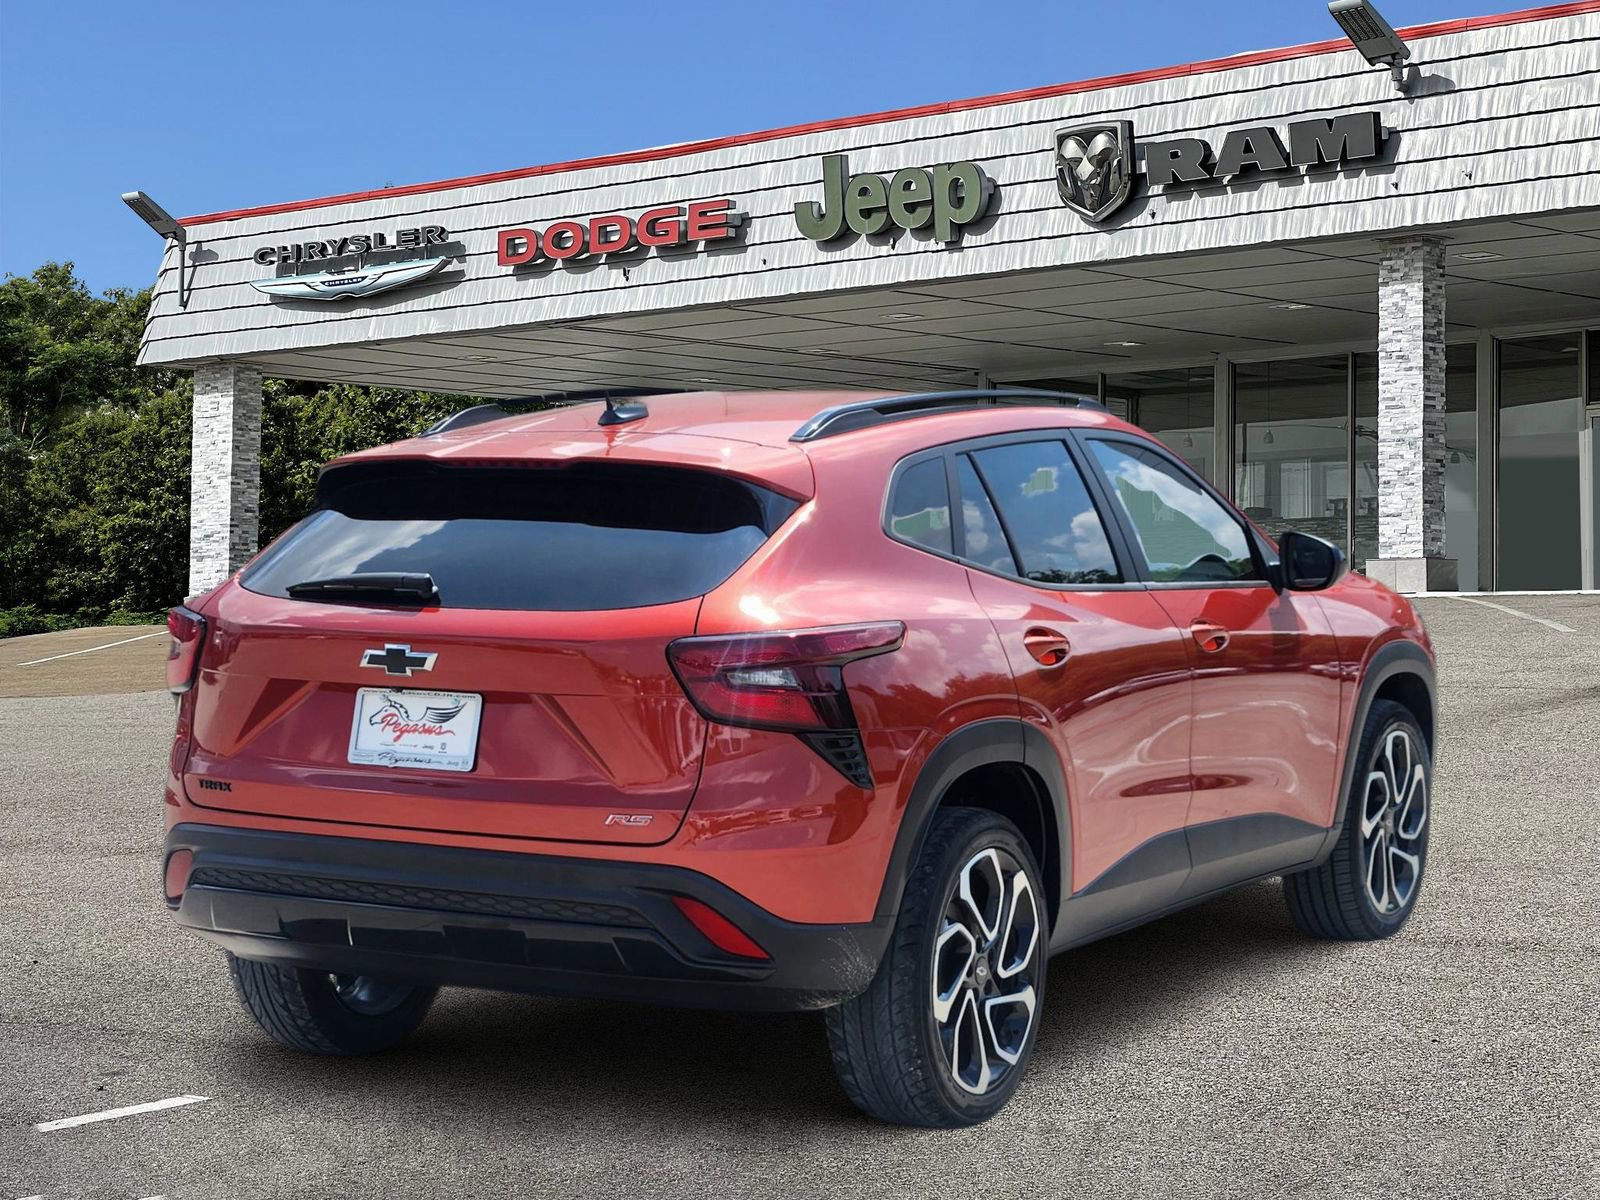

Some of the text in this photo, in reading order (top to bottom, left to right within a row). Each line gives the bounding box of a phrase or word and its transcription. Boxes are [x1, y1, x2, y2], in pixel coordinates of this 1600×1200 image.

[1146, 111, 1381, 186] RAM
[795, 154, 987, 242] Jeep
[253, 225, 449, 266] CHRYSLER
[498, 200, 735, 266] DODGE
[324, 277, 363, 287] CHRYSLER
[381, 712, 456, 742] Pegasus
[198, 779, 232, 793] TRAX
[604, 814, 653, 826] RS
